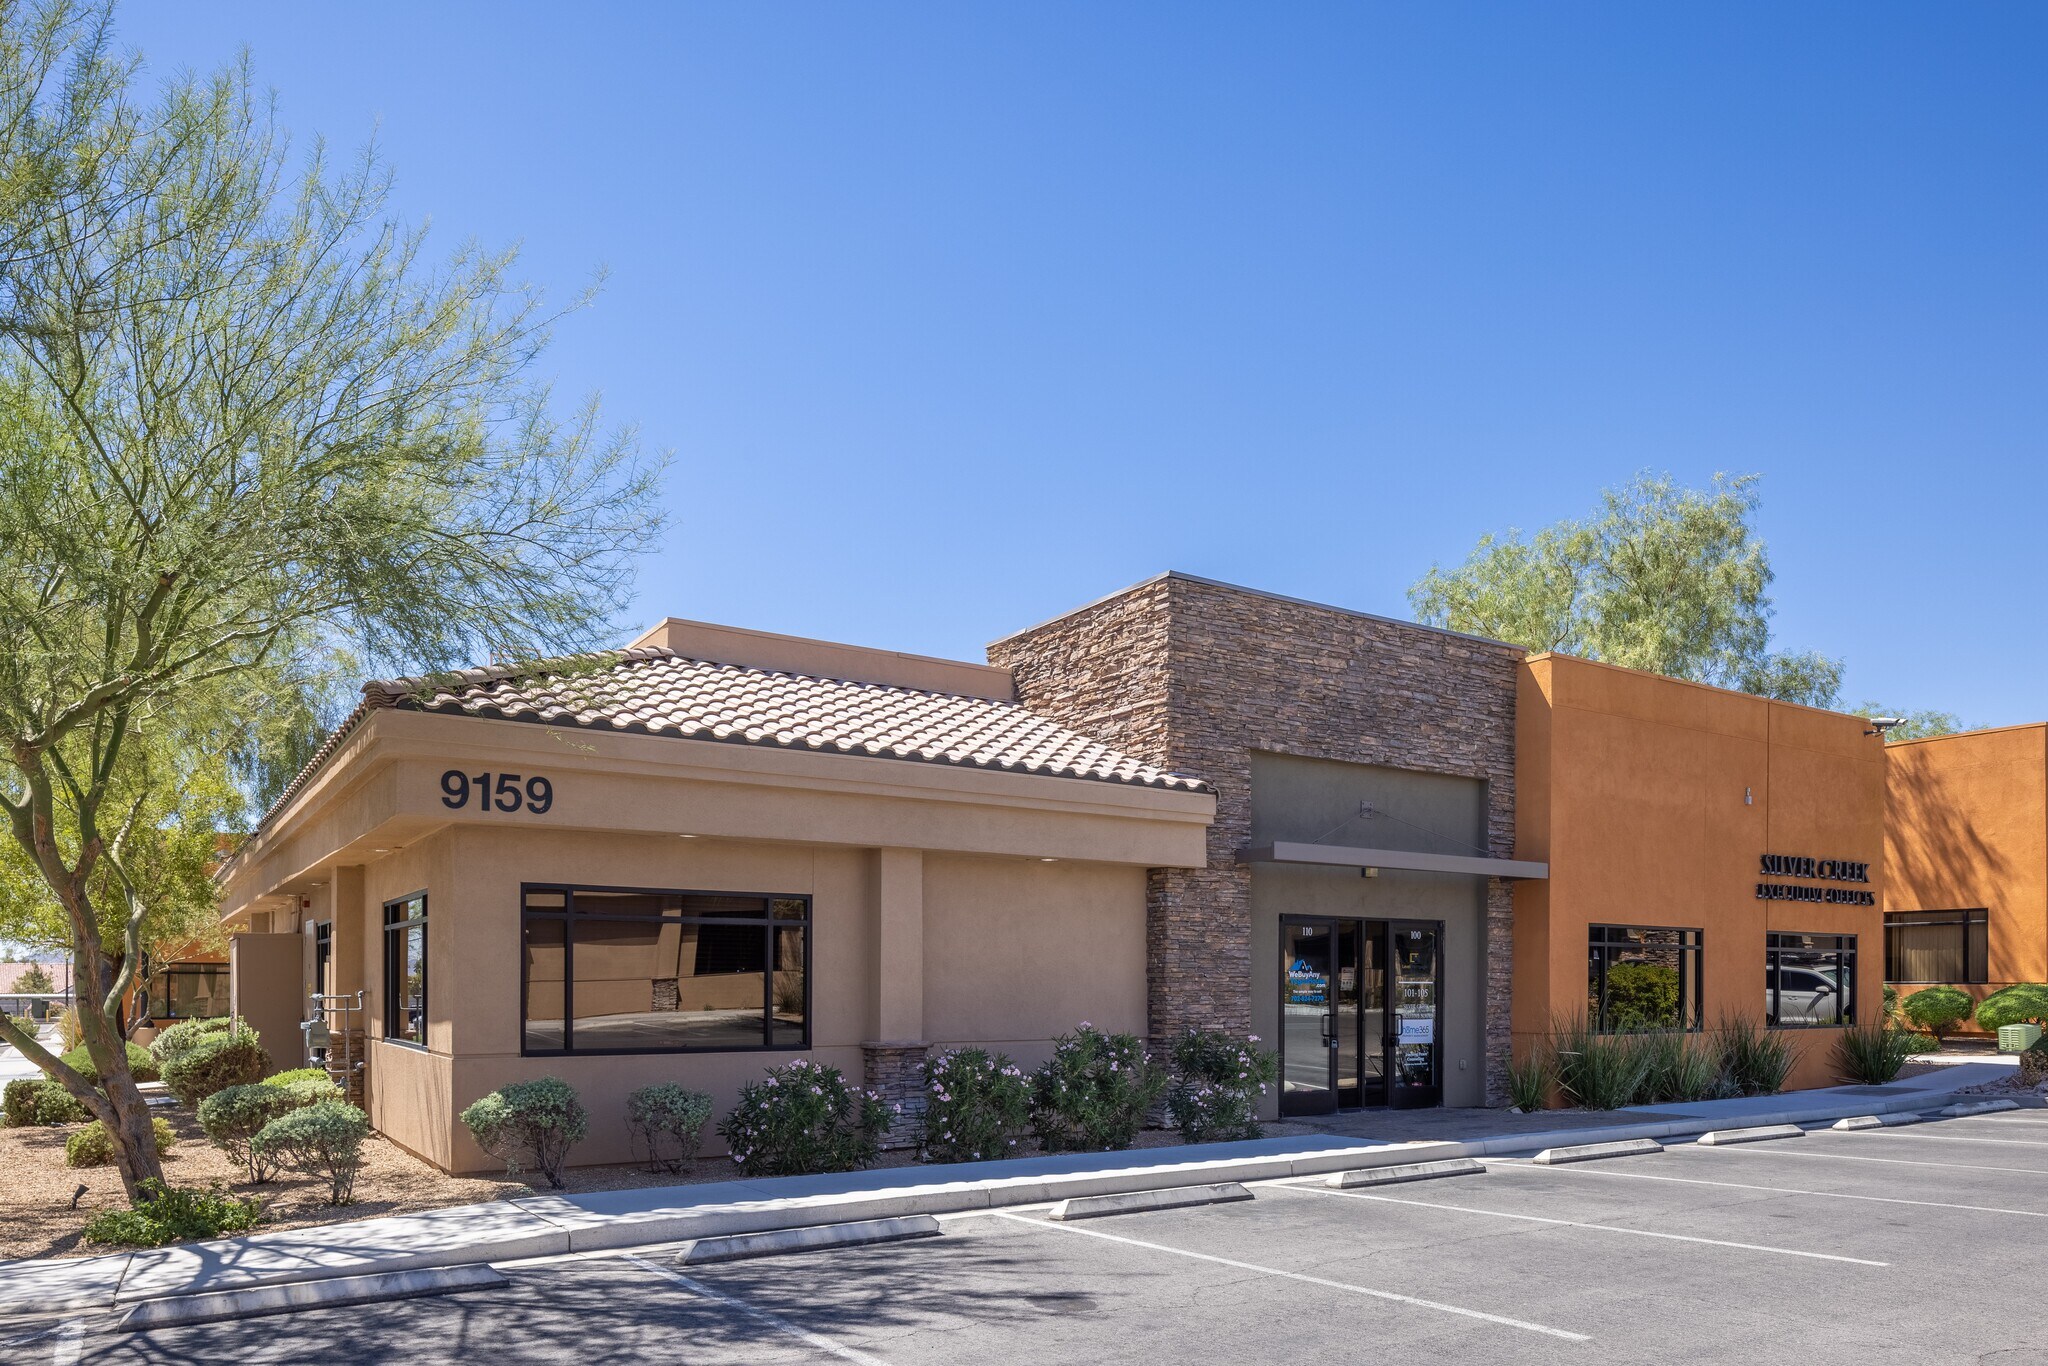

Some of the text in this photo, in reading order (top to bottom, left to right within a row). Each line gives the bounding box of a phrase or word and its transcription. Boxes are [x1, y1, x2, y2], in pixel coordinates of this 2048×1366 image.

[441, 770, 553, 814] 9159
[1760, 854, 1871, 883] SILVER CREEK
[1826, 888, 1876, 906] OFFICES
[1302, 926, 1313, 936] 110
[1410, 930, 1422, 940] 100
[1288, 970, 1320, 979] WeBuyAny
[1404, 988, 1429, 998] 101-105
